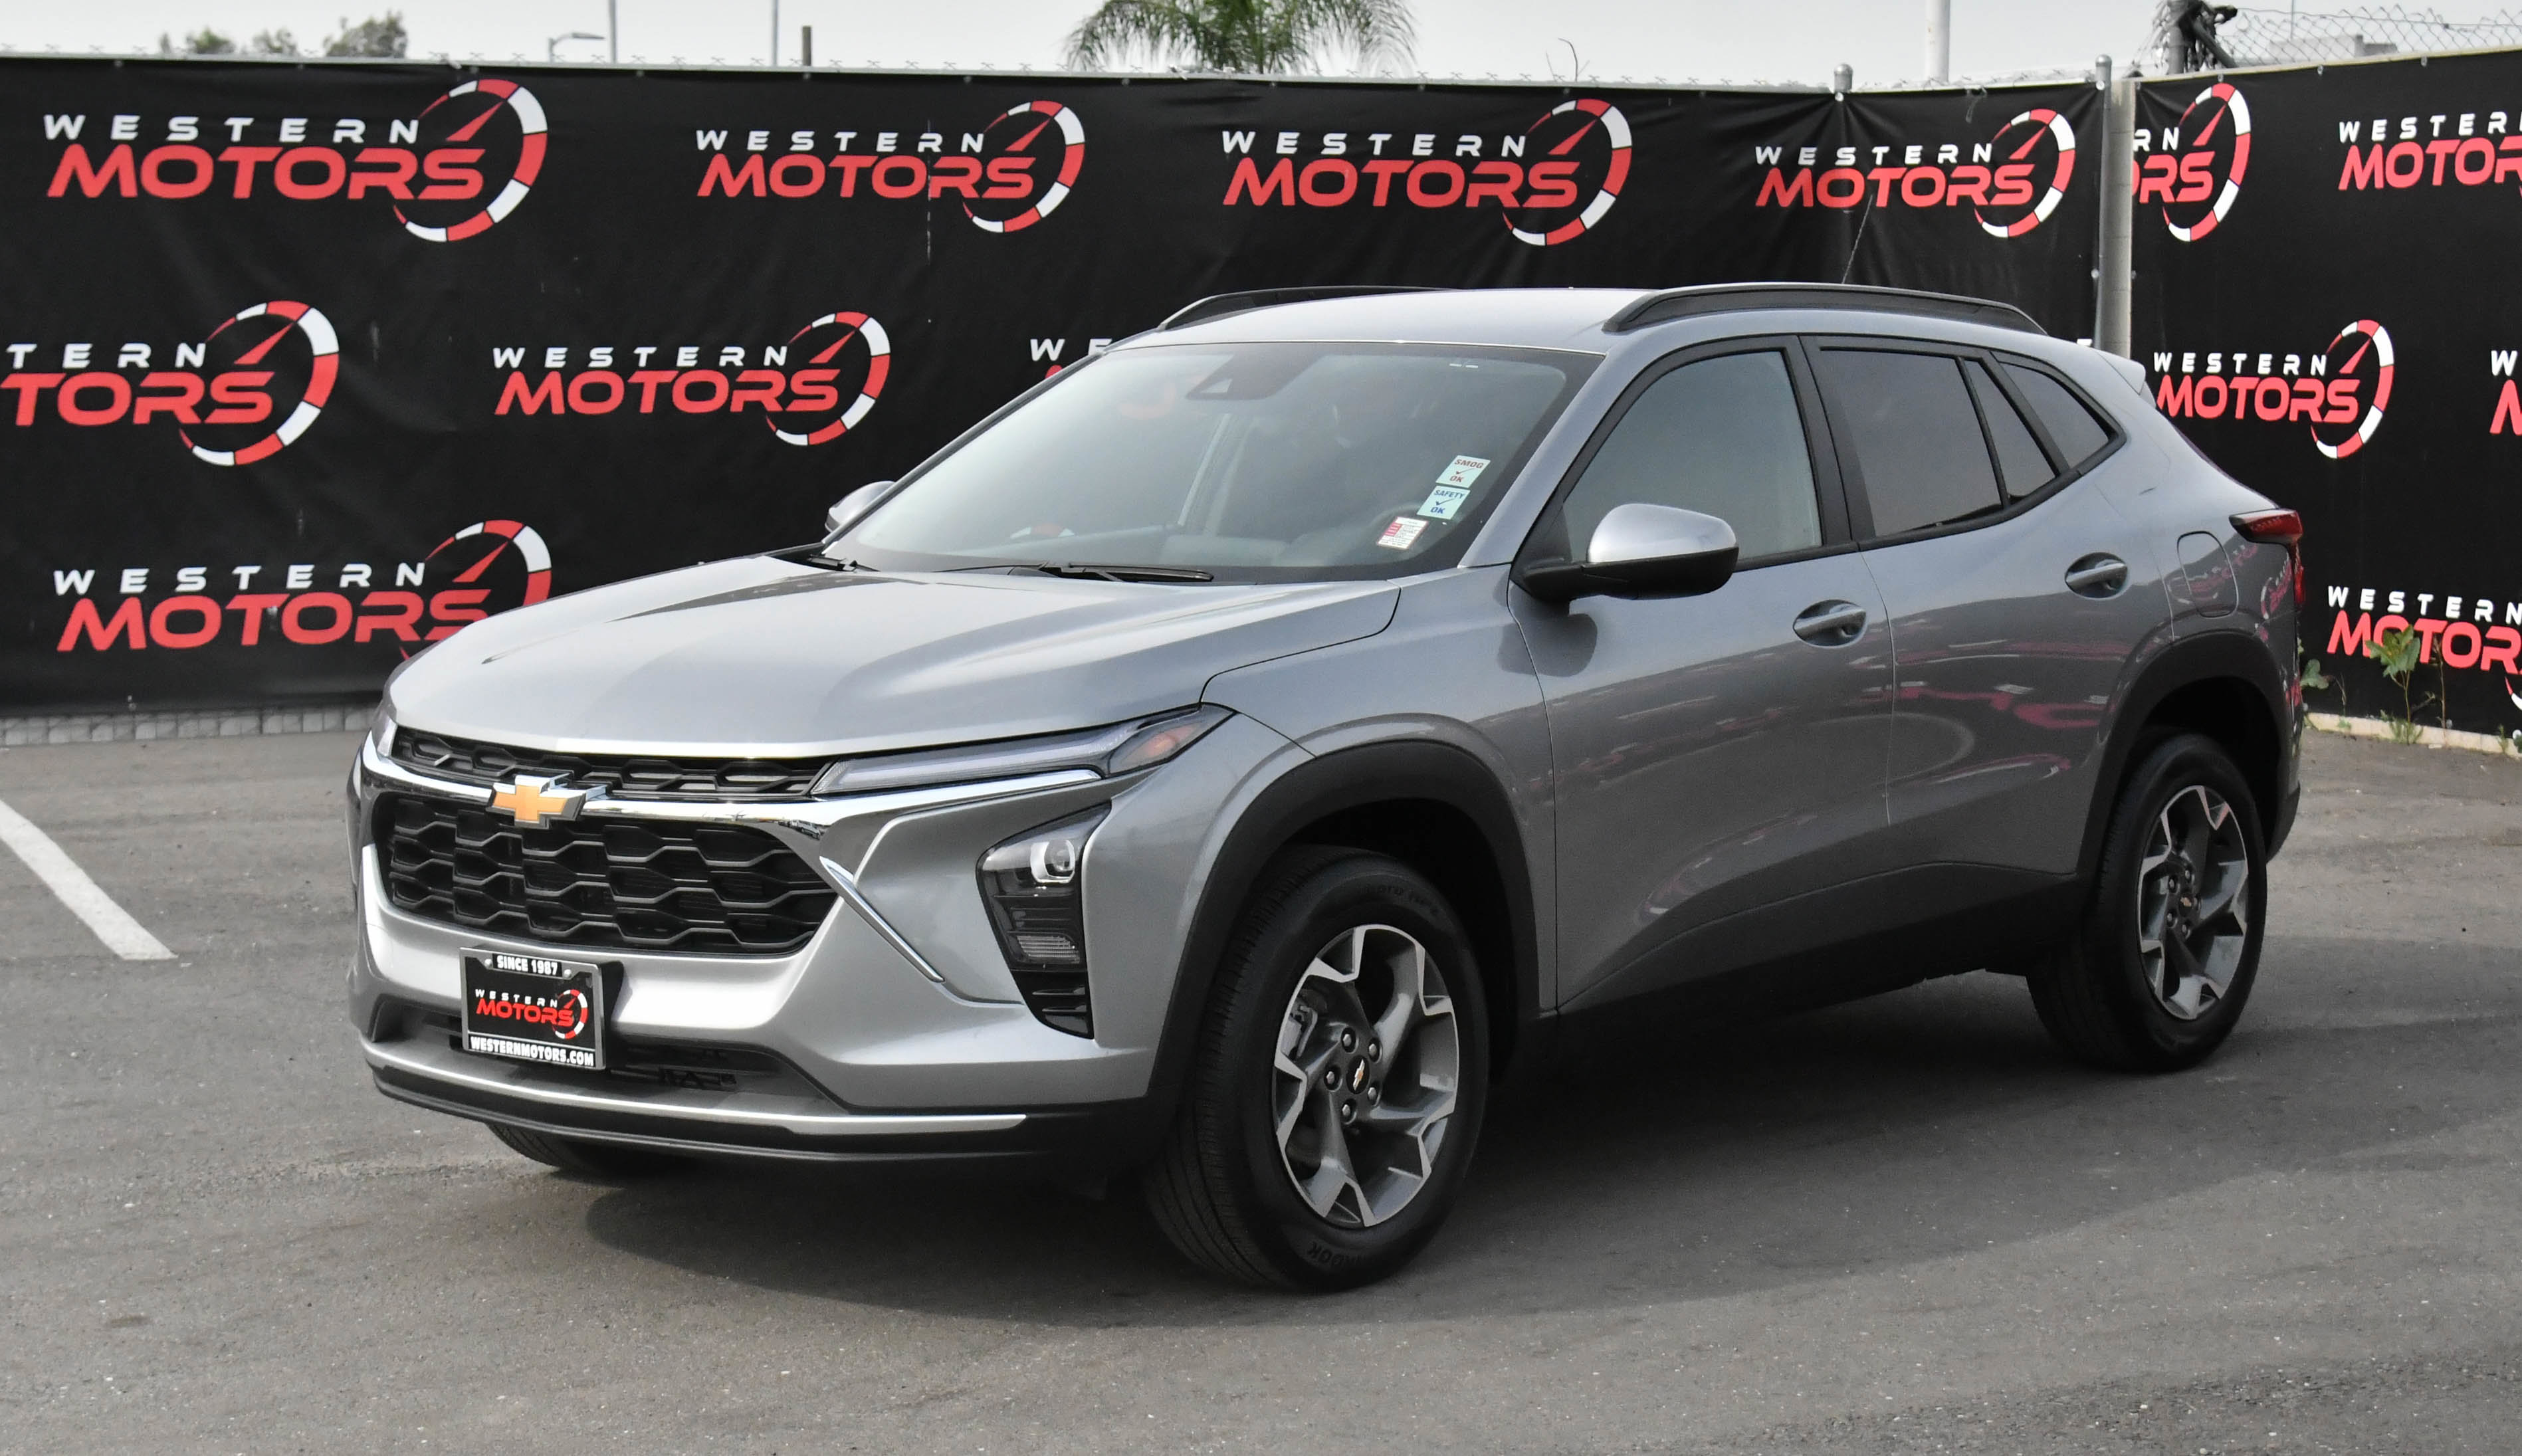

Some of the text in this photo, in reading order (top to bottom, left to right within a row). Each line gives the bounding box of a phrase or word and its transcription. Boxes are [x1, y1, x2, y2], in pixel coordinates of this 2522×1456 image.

[43, 114, 419, 144] WESTERN
[695, 130, 985, 153] WESTERN
[2338, 110, 2522, 144] WESTER
[1221, 130, 1526, 157] WESTERN
[1754, 143, 1993, 166] WESTERN
[47, 143, 486, 200] MOTORS
[696, 153, 1037, 199] MOTORS
[1222, 157, 1581, 209] MOTORS
[1755, 163, 2036, 209] MOTORS
[492, 345, 788, 369] WESTERN
[2153, 351, 2328, 377] WESTERN
[494, 368, 841, 416] MOTORS
[2156, 373, 2362, 425] MOTORS
[1454, 459, 1484, 469] SMOG
[1433, 489, 1465, 500] SAFETY
[53, 561, 426, 597] WESTERN
[56, 588, 492, 653] MOTORS
[2327, 585, 2522, 626] WESTERN
[2326, 609, 2522, 676] MTOR
[496, 955, 559, 976] SINCE 1987
[474, 988, 559, 1009] WESTERN
[476, 997, 575, 1027] MOTORS
[470, 1035, 594, 1067] WESTERNMOTORS.COM
